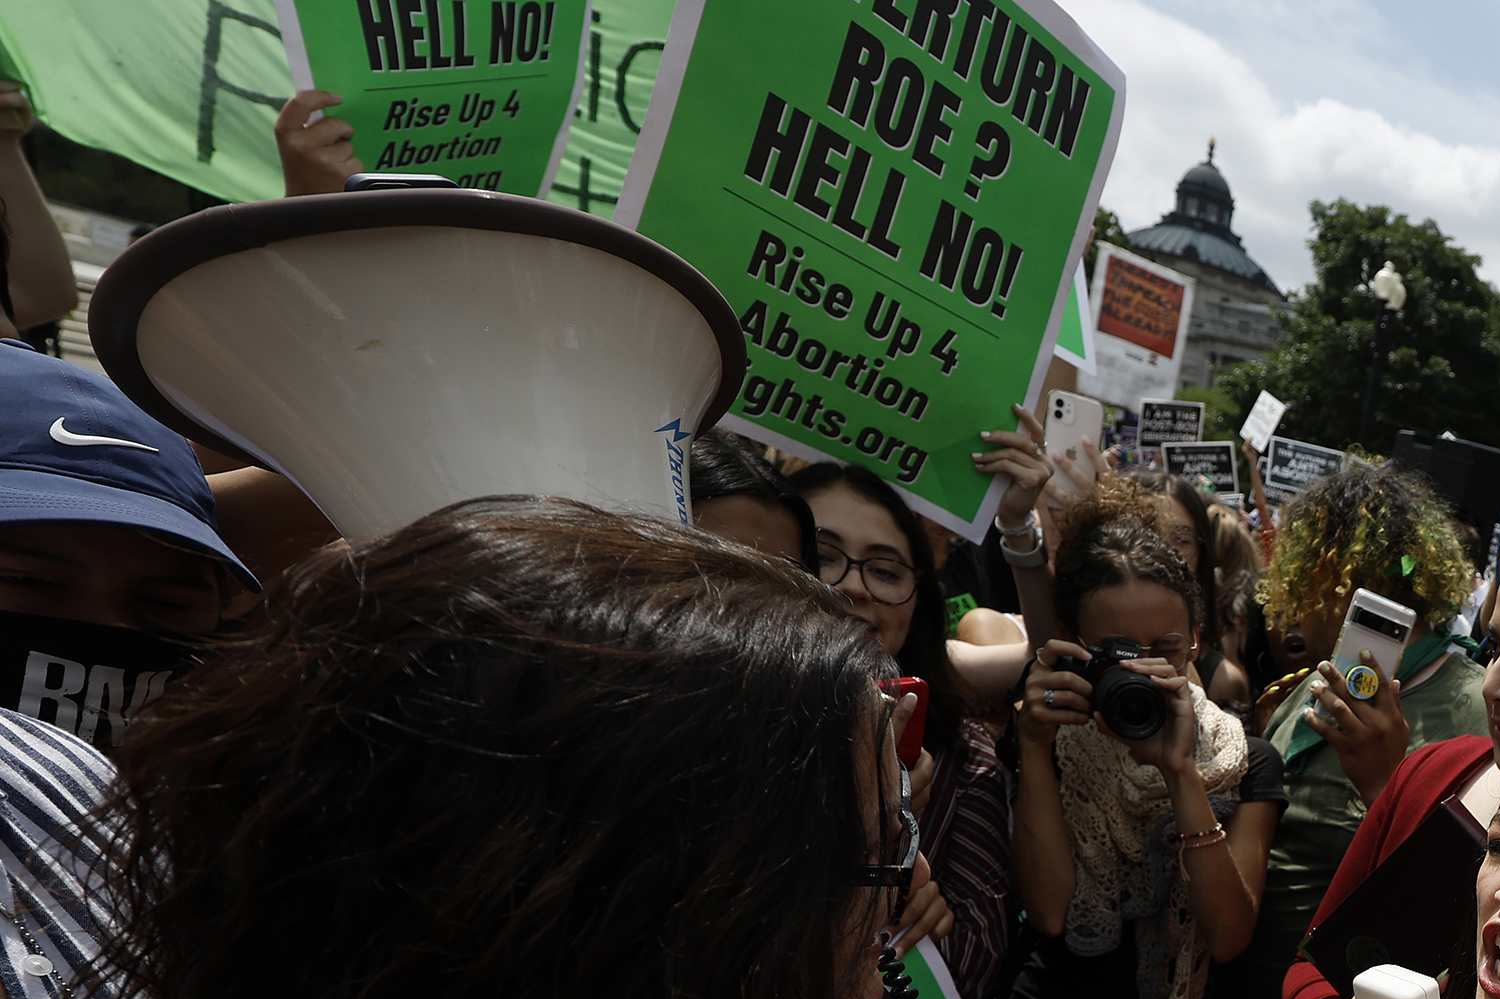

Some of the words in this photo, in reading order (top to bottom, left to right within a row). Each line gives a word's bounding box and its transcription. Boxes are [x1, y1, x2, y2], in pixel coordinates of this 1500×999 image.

[357, 0, 475, 73] HELL
[489, 1, 555, 67] NO!
[375, 132, 502, 171] Abortion
[383, 97, 451, 132] Rise
[458, 92, 495, 129] Up
[502, 88, 521, 119] 4
[829, 20, 963, 179] ROE
[964, 120, 1012, 202] ?
[743, 91, 902, 262] HELL
[919, 198, 1024, 321] NO!
[739, 299, 930, 423] Abortion
[746, 229, 854, 320] Rise
[863, 291, 922, 361] Up
[929, 328, 960, 377] 4
[746, 357, 930, 484] ghts.org
[1115, 649, 1139, 659] SONY
